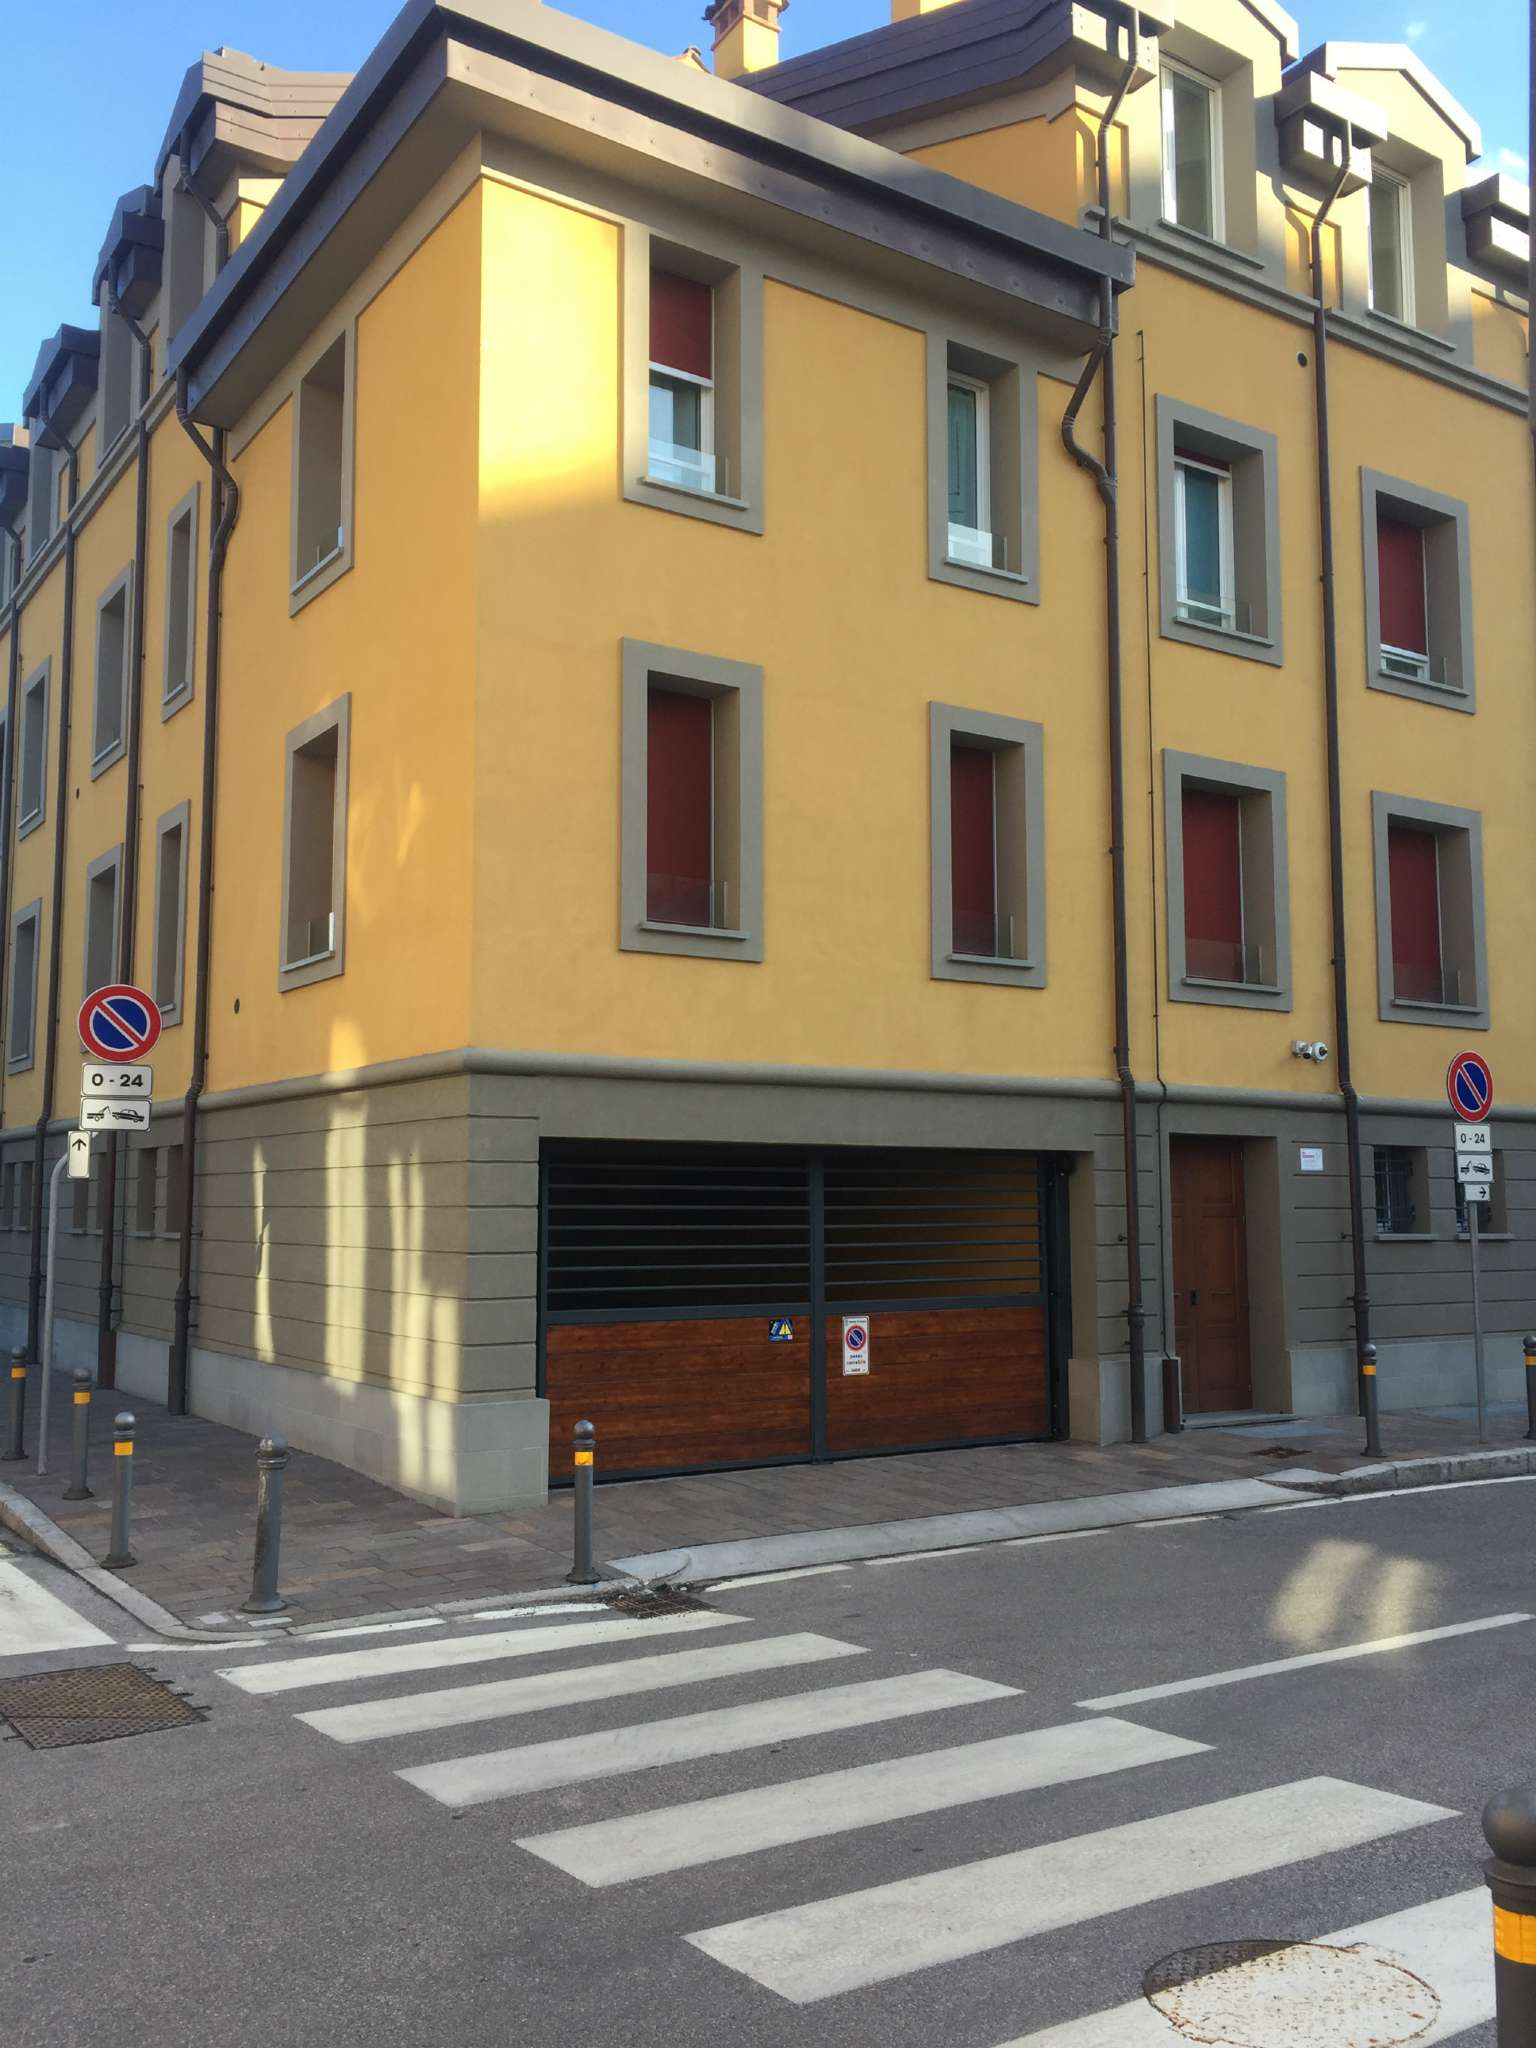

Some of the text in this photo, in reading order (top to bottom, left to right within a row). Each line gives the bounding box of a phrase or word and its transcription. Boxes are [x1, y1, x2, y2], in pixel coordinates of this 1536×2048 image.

[92, 1073, 103, 1086] 0
[119, 1073, 143, 1087] 24
[1460, 1133, 1467, 1143] 0
[1474, 1133, 1485, 1143] 24
